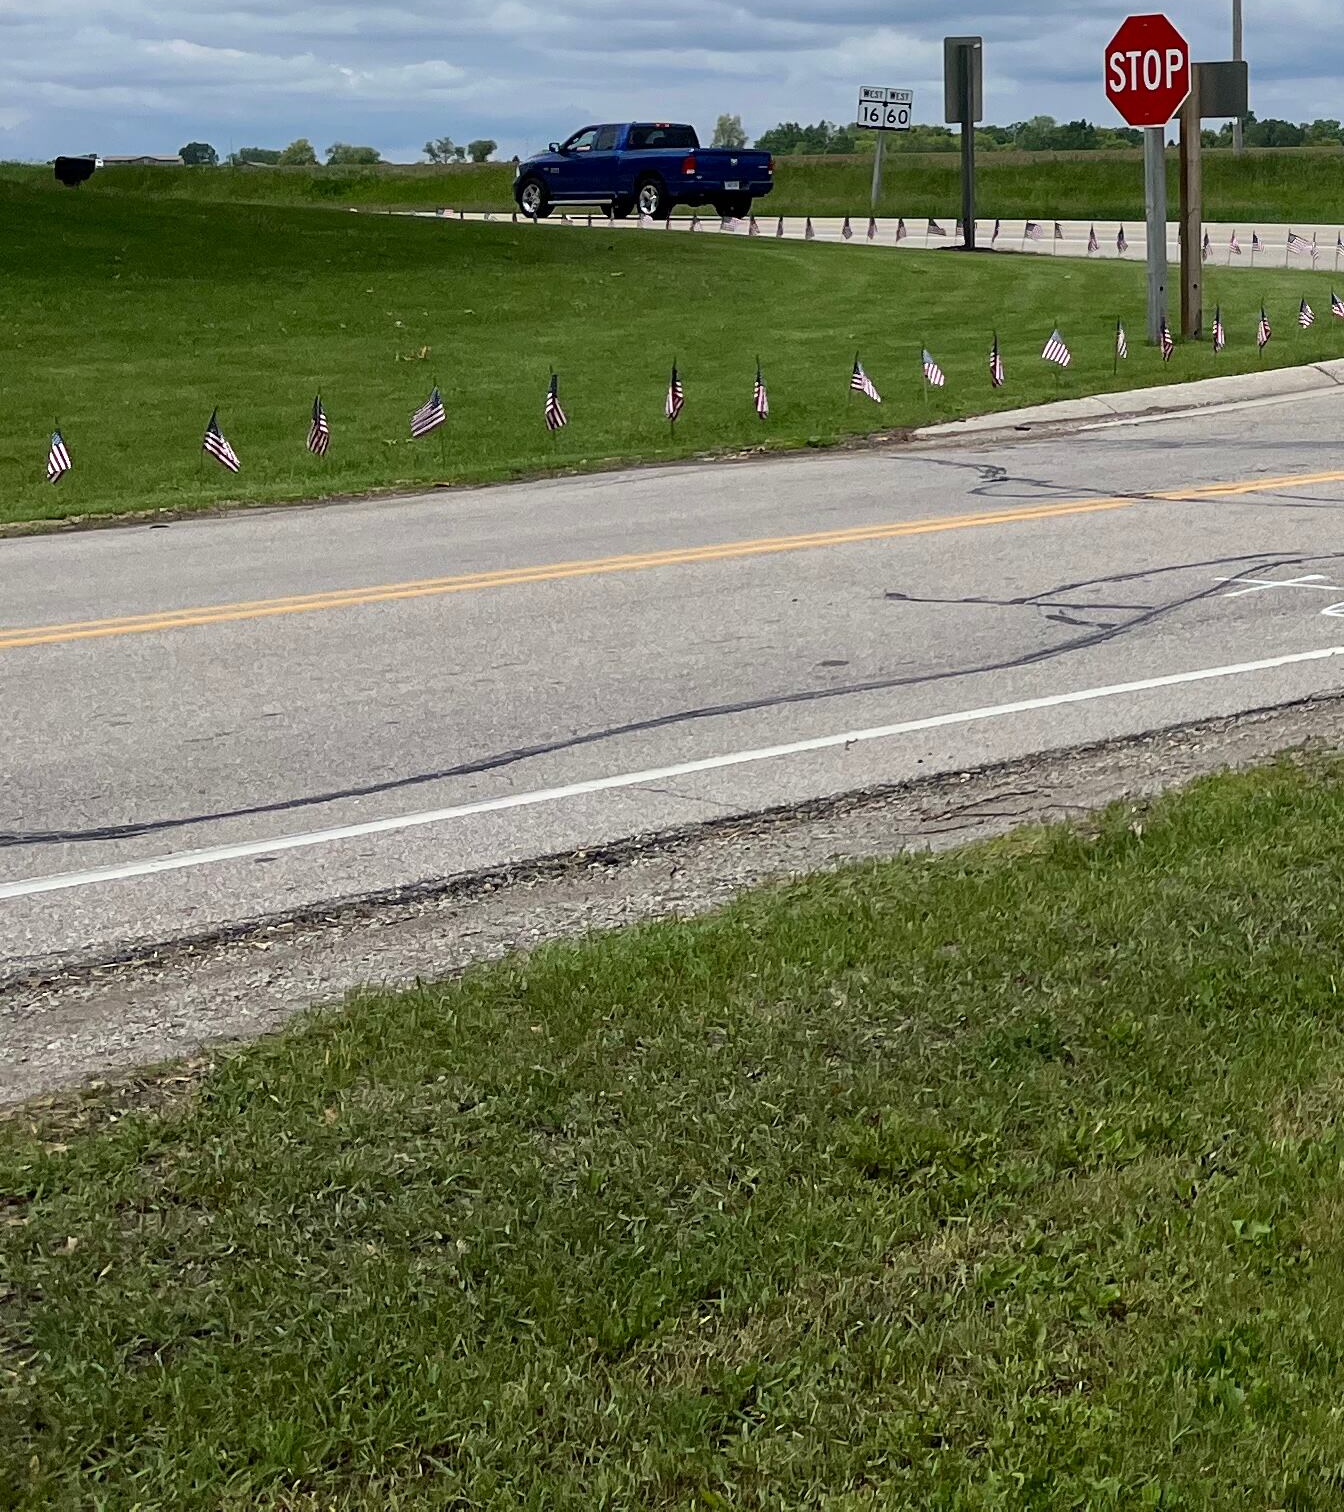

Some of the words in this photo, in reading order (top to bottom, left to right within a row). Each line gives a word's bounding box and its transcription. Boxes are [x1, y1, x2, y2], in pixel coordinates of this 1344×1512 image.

[1109, 48, 1184, 93] STOP
[863, 88, 883, 99] WEST
[890, 91, 909, 101] WEST
[863, 106, 879, 122] 16
[886, 108, 908, 125] 60
